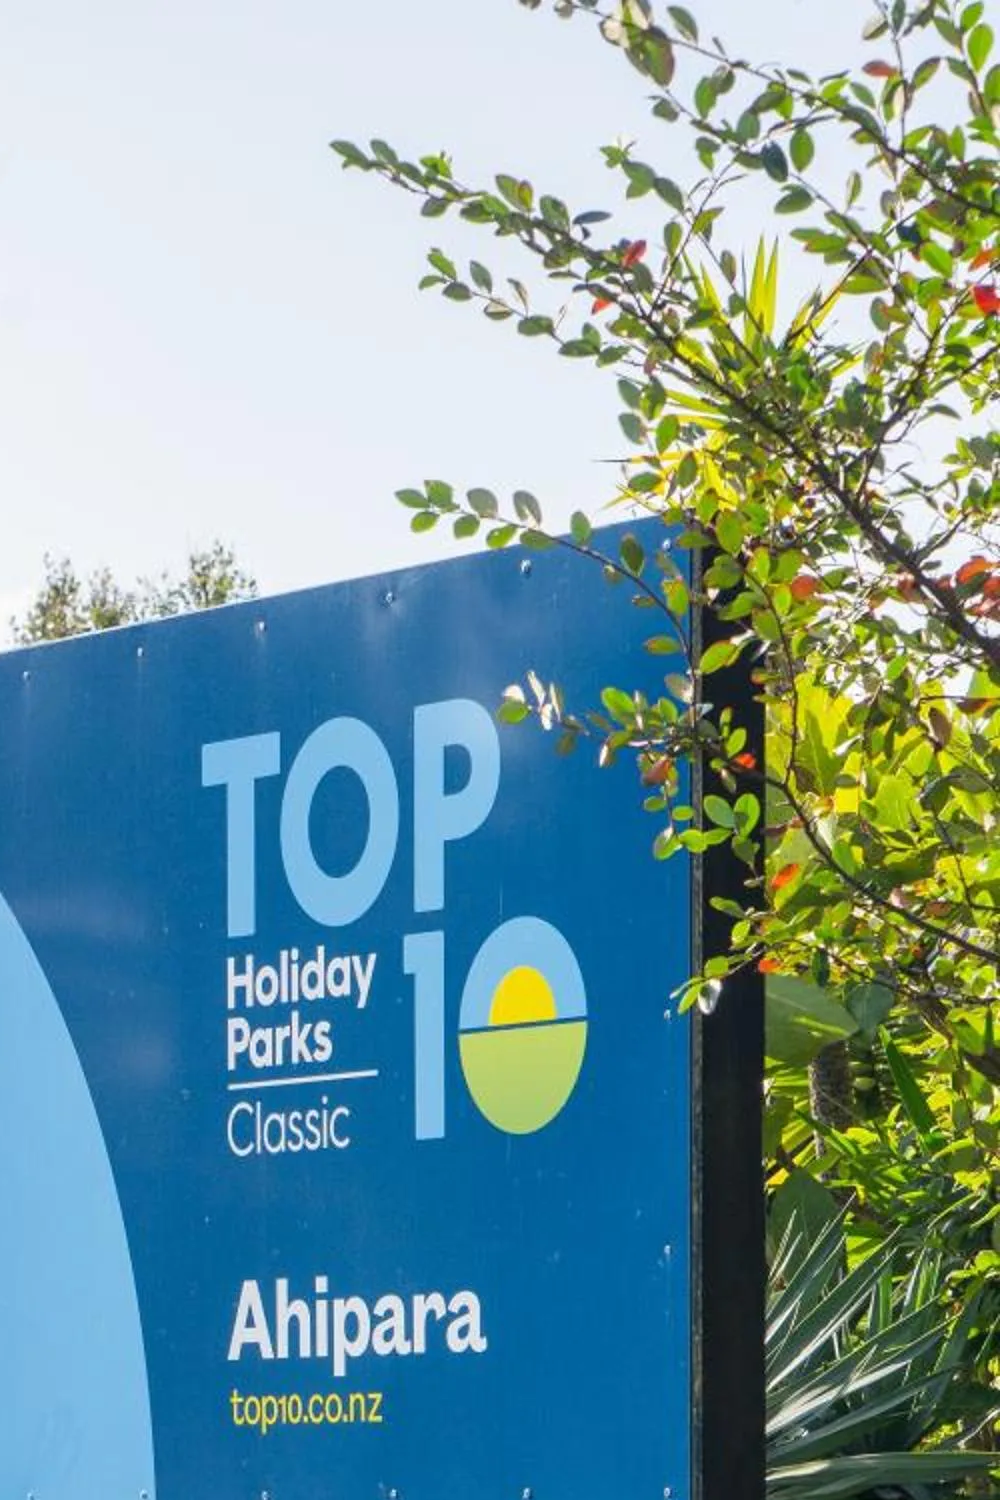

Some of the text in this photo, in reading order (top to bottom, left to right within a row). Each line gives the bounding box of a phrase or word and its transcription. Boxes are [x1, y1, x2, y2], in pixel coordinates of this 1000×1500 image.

[201, 699, 500, 938] TOP
[226, 945, 377, 1009] Holiday
[226, 1010, 333, 1071] Parks
[402, 915, 589, 1141] 10
[226, 1096, 351, 1157] Classic
[227, 1275, 488, 1377] Ahipara
[230, 1388, 384, 1435] top10.co.nz
